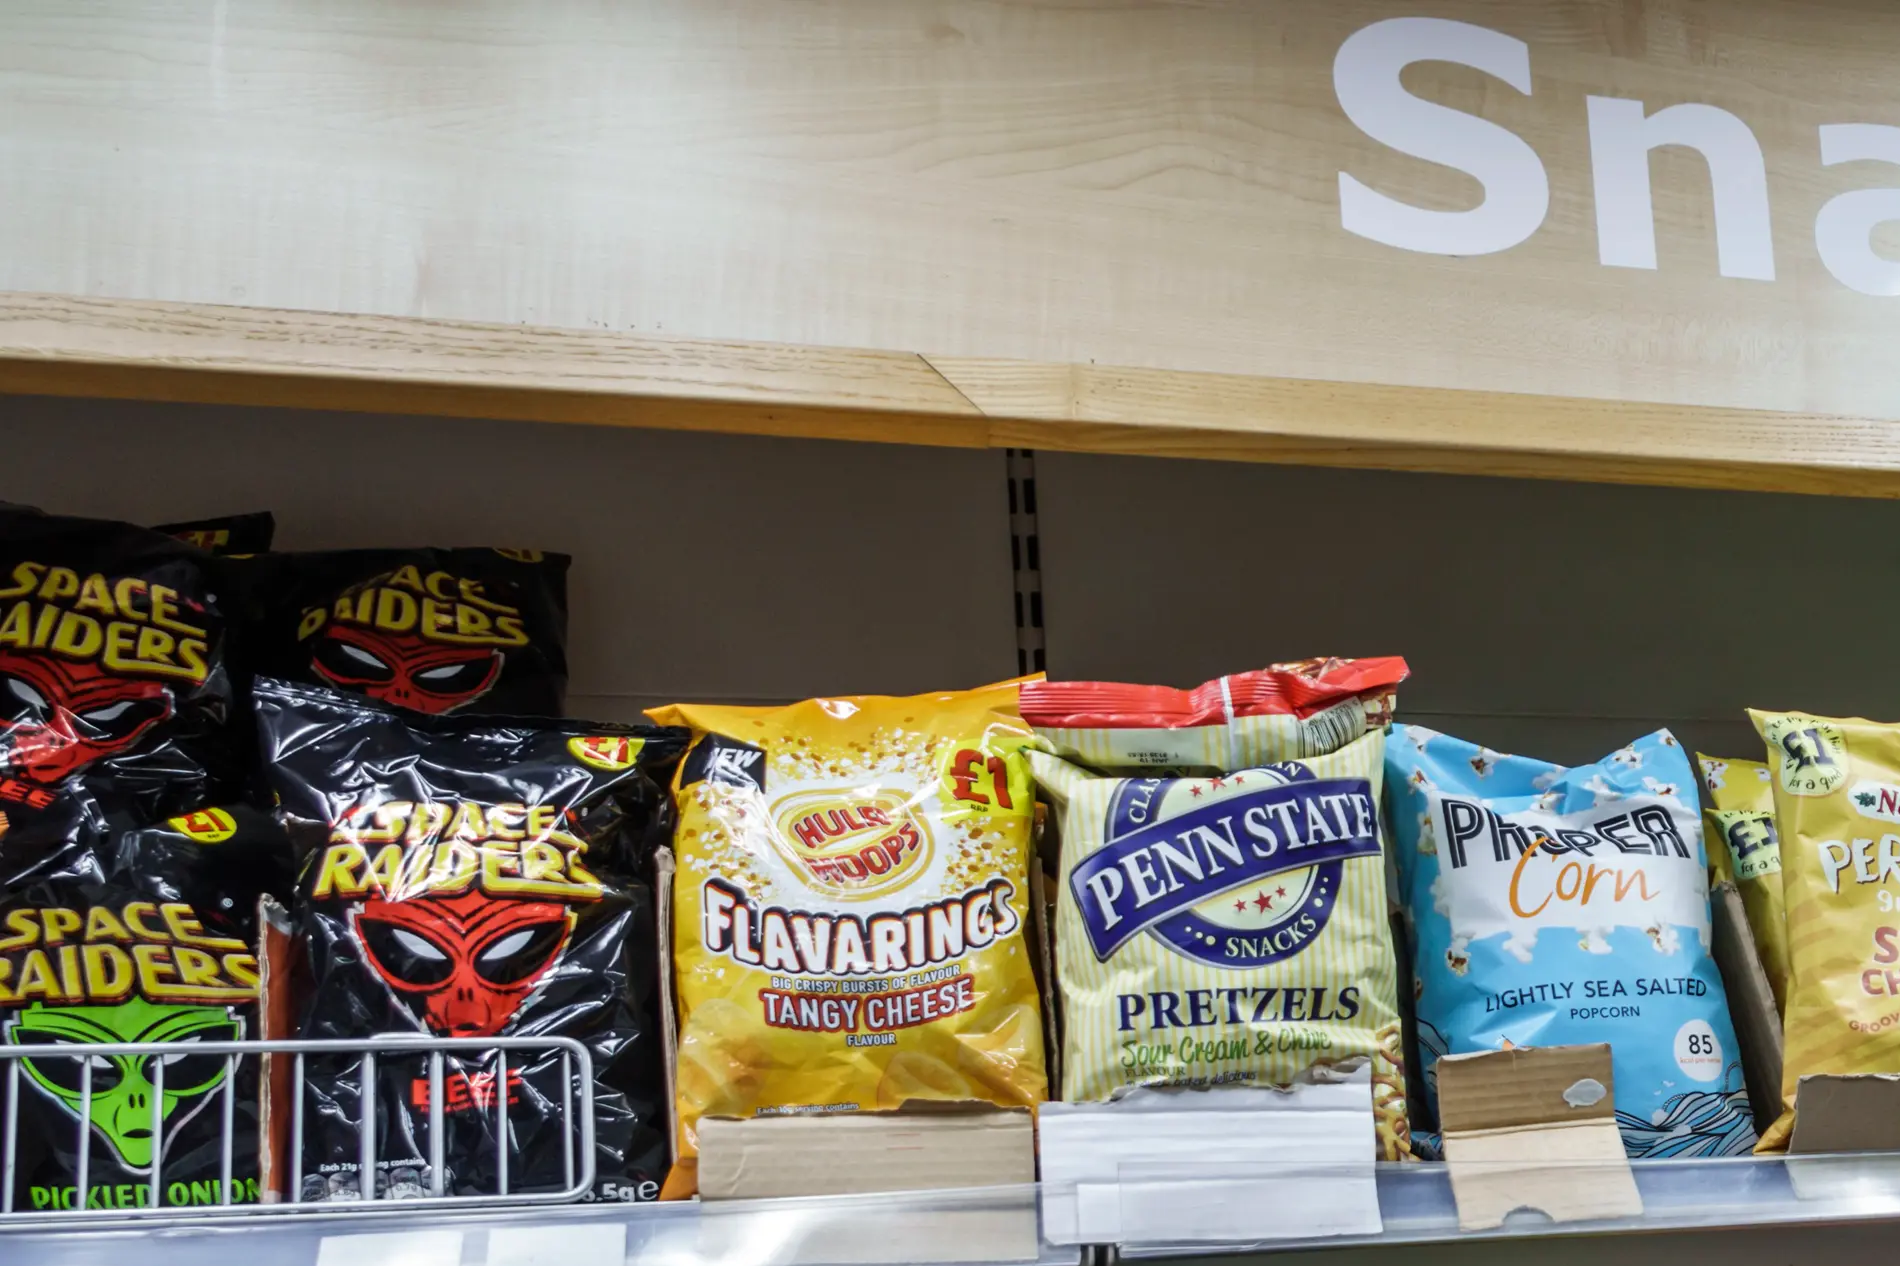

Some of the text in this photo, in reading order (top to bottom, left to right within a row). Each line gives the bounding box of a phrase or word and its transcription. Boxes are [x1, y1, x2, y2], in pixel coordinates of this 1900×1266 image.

[0, 561, 207, 638] SPACE
[950, 748, 1014, 811] £1
[795, 806, 892, 849] HULA
[803, 823, 921, 884] HOOPS
[1086, 792, 1374, 932] PENN STATE
[1508, 836, 1662, 919] Corn
[2, 901, 244, 950] SPACE
[704, 878, 1021, 976] FLAVARINGS
[1224, 912, 1318, 960] SNACKS
[771, 964, 961, 994] BIG CRISPY BURSTS OF FLAVOUR
[1485, 977, 1708, 1014] LIGHTLY SEA SALTED
[763, 978, 972, 1030] TANGY CHEESE
[1117, 986, 1361, 1032] PRETZELS
[1570, 1005, 1642, 1021] POPCORN
[846, 1033, 897, 1048] FLAVOUR
[1120, 1028, 1333, 1070] Sour Cream & Chive
[1687, 1033, 1714, 1056] 85
